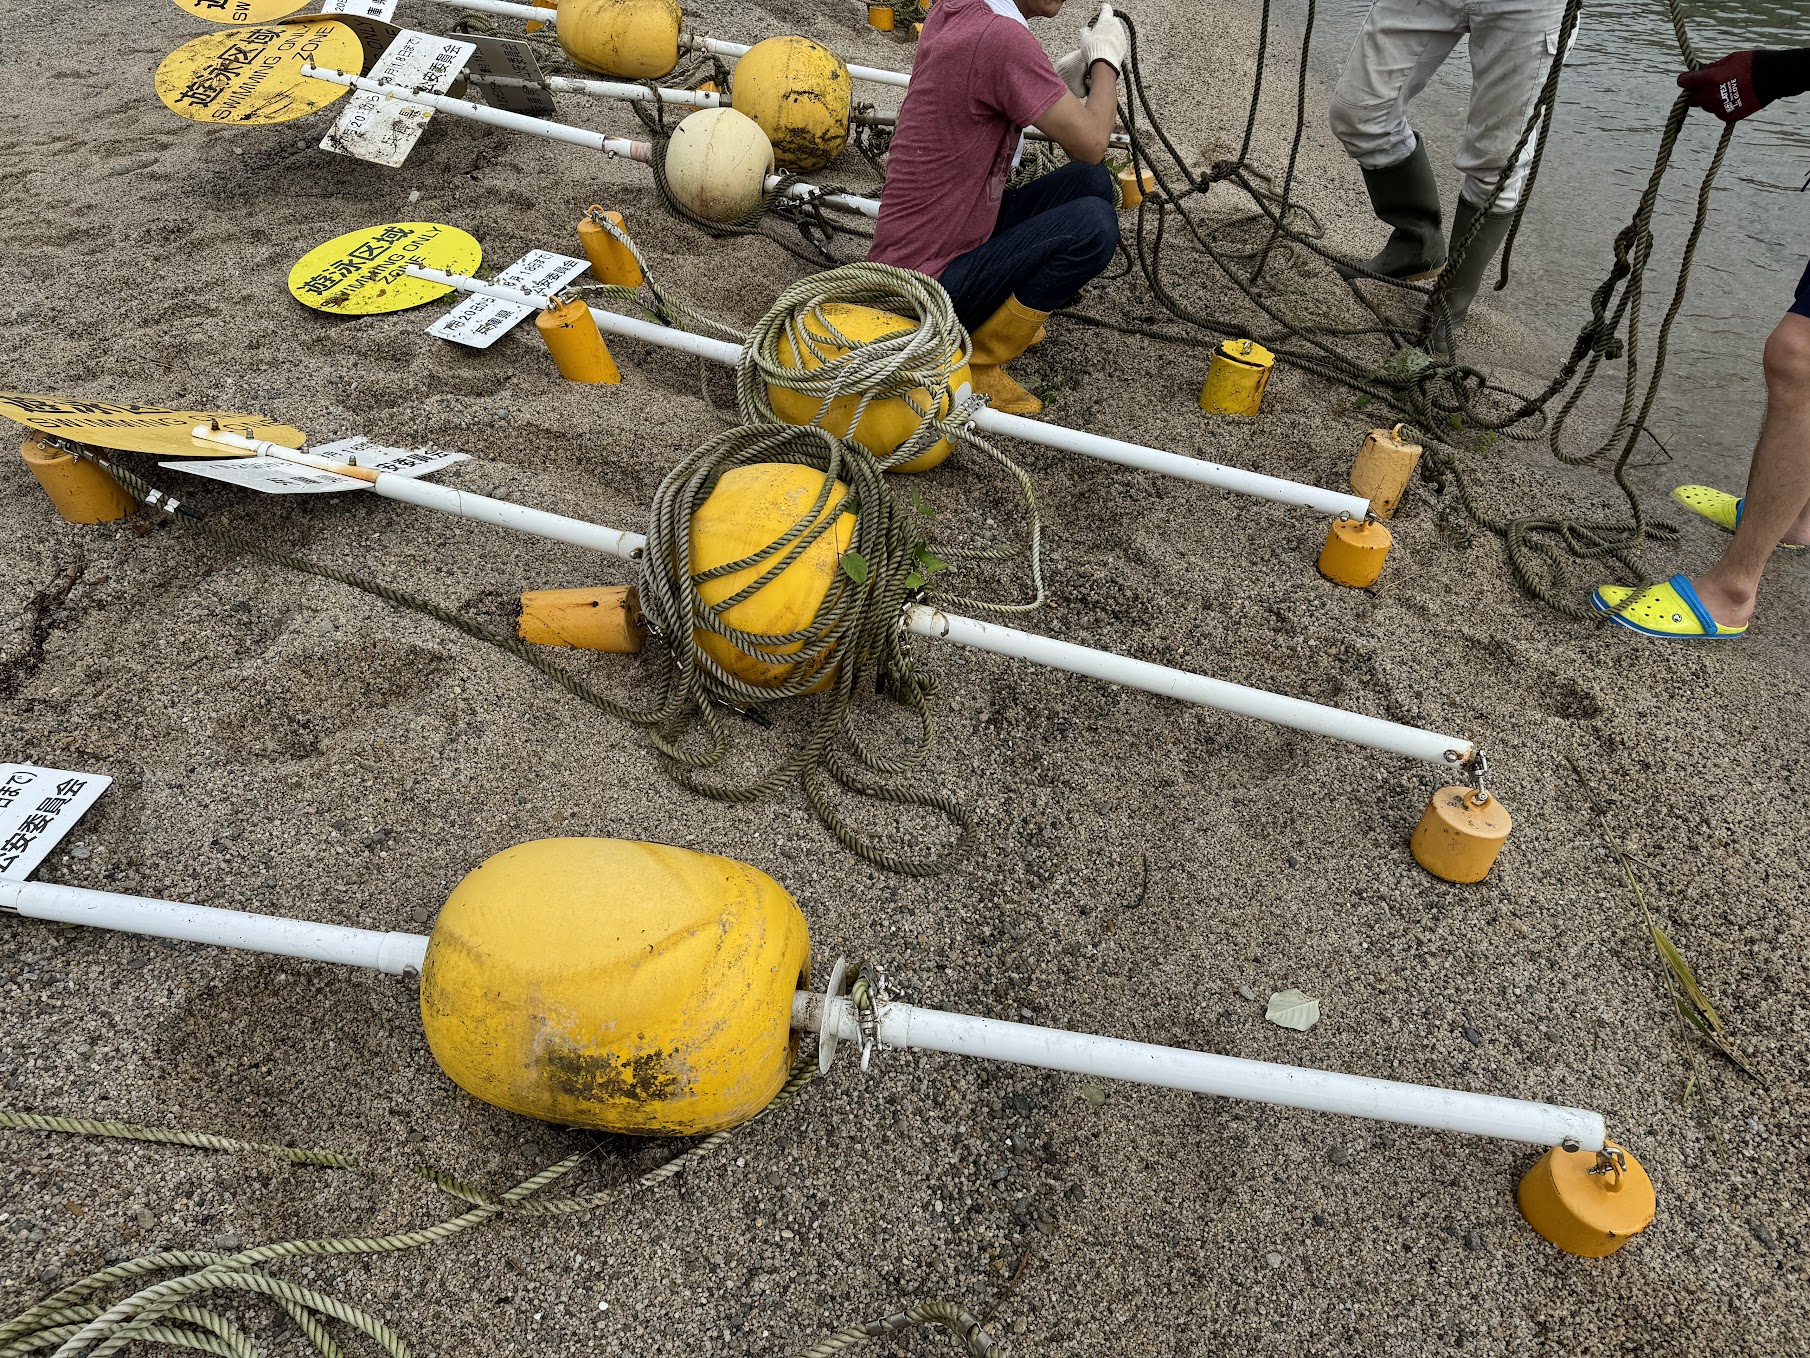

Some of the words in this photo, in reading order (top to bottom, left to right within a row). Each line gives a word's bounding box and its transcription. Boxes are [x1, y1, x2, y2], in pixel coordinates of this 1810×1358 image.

[174, 27, 287, 108] 遊泳区域
[212, 55, 283, 121] SWIMMING
[278, 25, 313, 51] ONLY
[292, 26, 336, 61] ZONE
[297, 226, 414, 296] 遊泳区域
[318, 253, 406, 309] SIMMING
[402, 225, 443, 252] ONLY
[473, 309, 515, 336] 兵庫県
[531, 259, 580, 295] 公安委員会
[27, 417, 188, 428] SWIMMING
